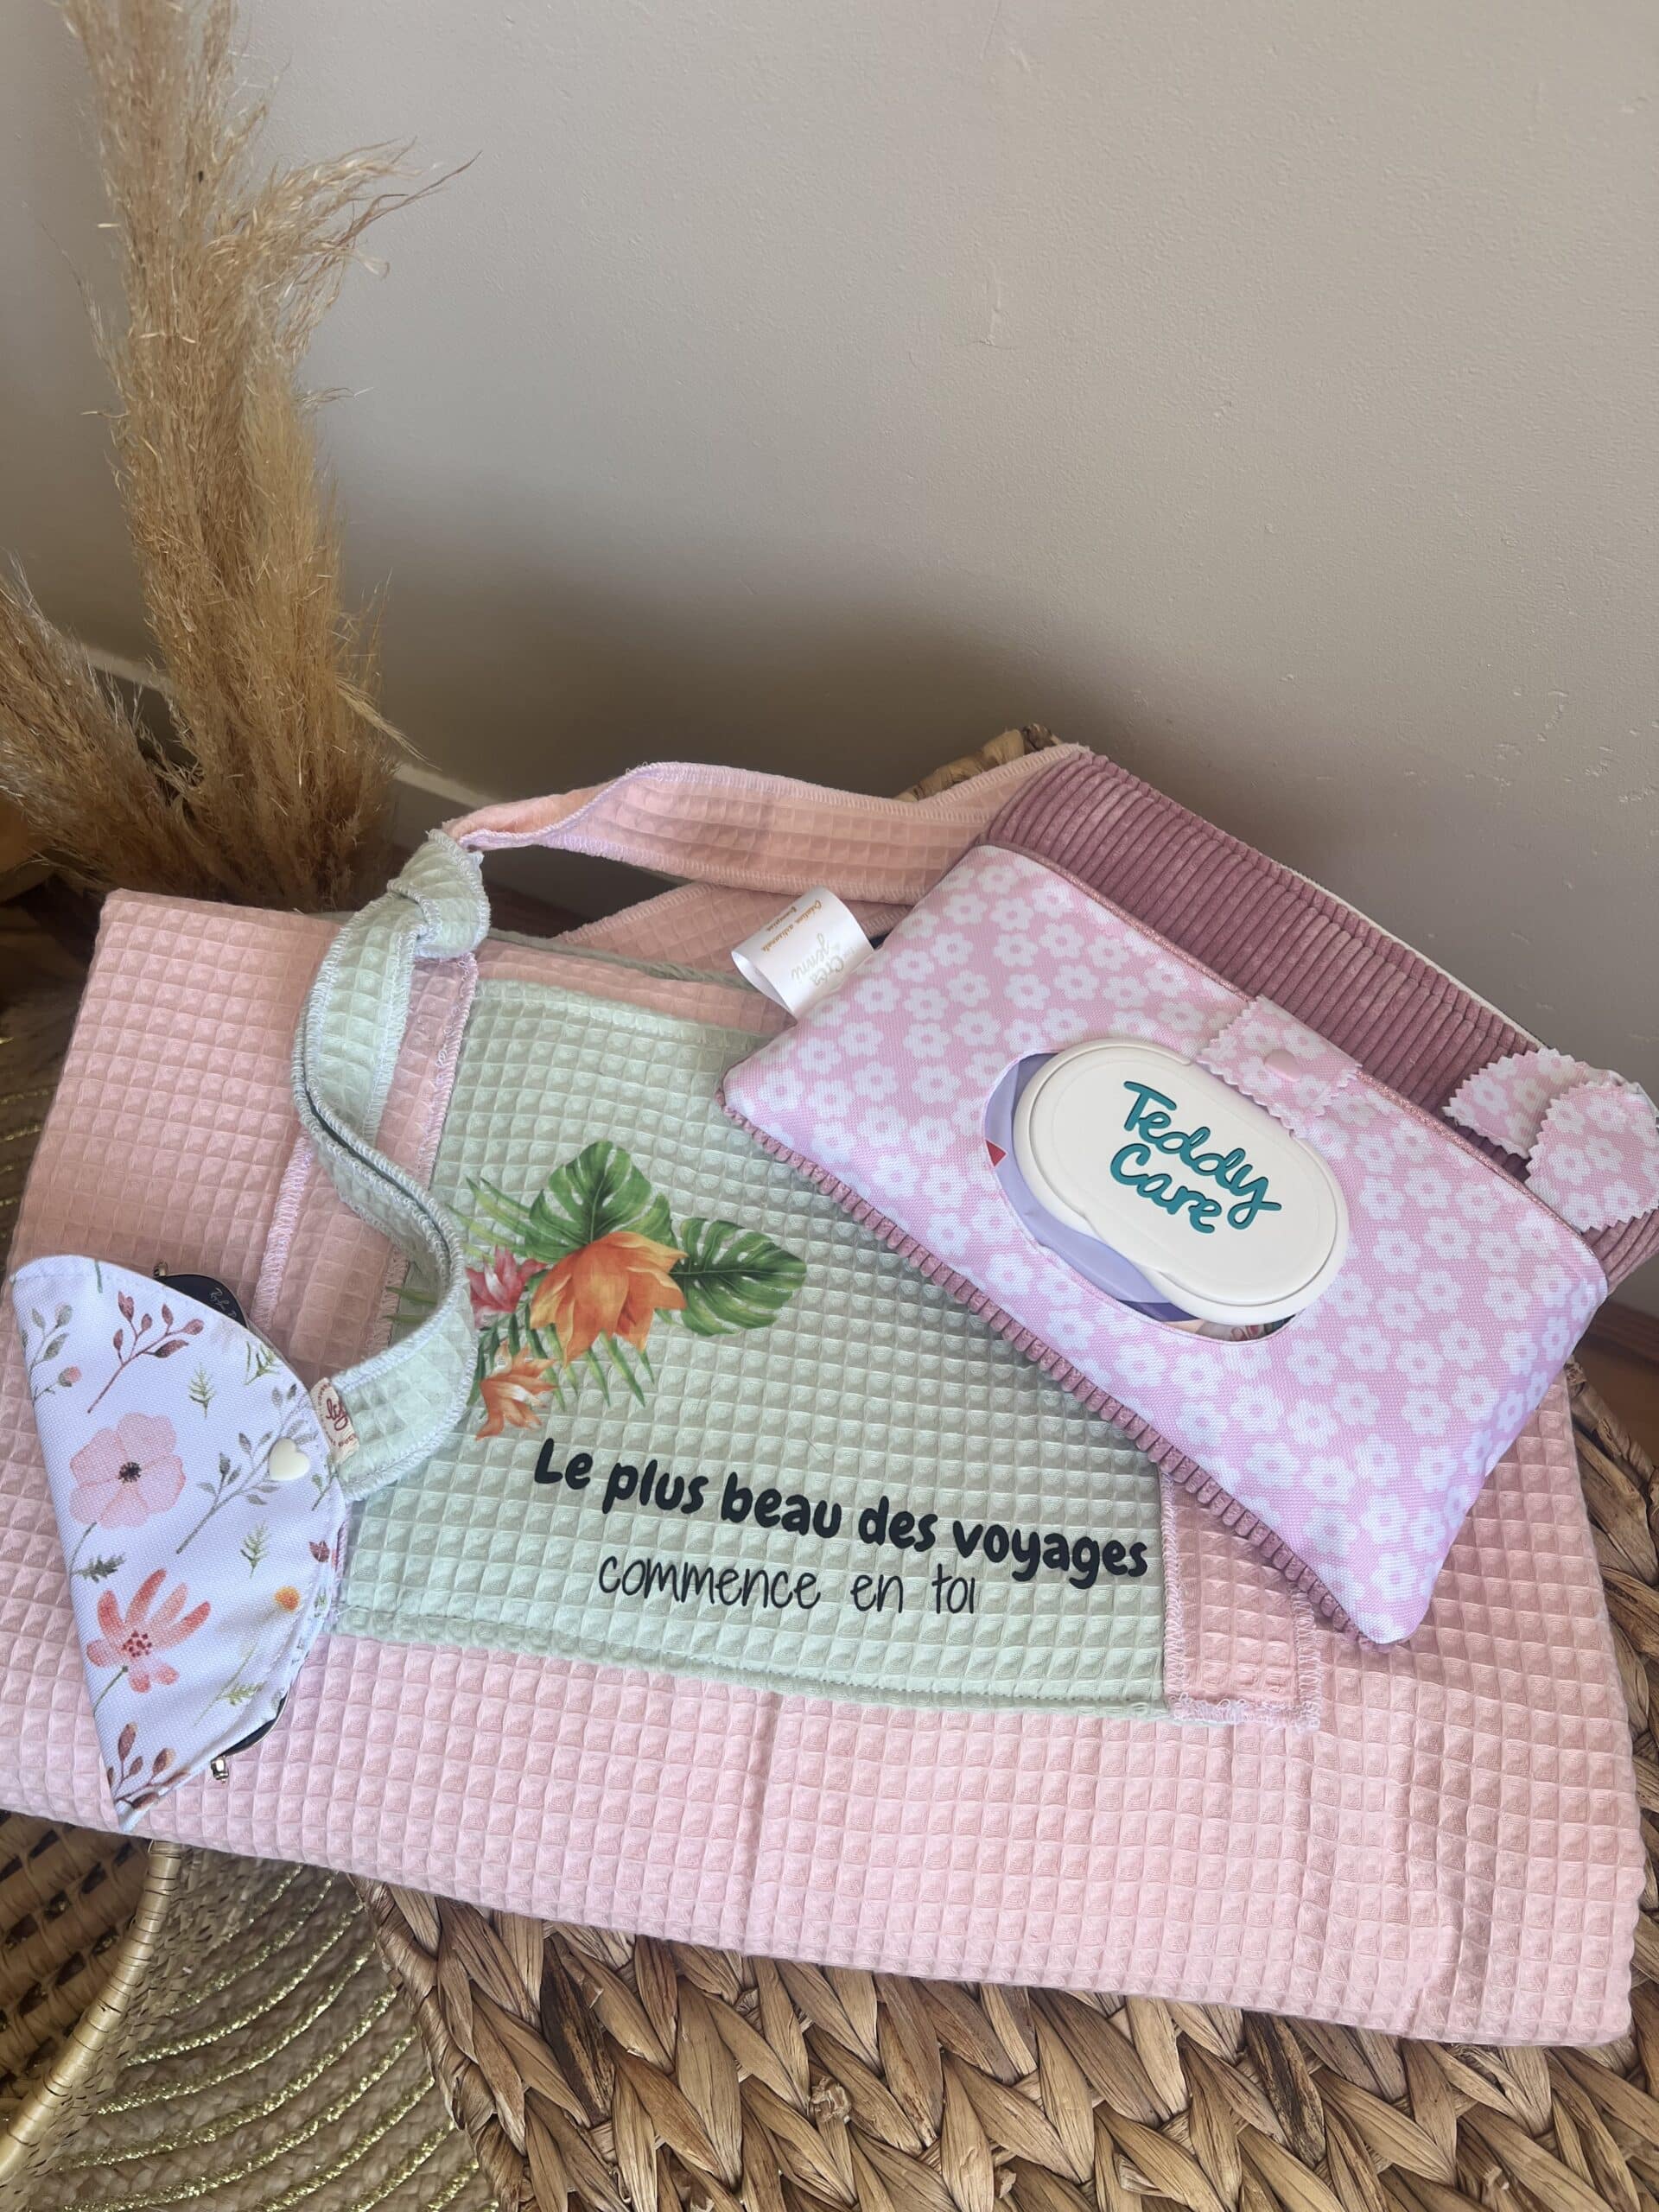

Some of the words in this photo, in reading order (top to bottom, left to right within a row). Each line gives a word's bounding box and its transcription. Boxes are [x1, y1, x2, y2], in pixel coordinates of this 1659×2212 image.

[1109, 1143, 1222, 1234] Care
[1124, 1081, 1281, 1230] Teddy
[534, 1437, 594, 1491] Le
[601, 1459, 709, 1515] plus
[721, 1471, 842, 1539] beau
[858, 1496, 938, 1553] des
[952, 1520, 1148, 1590] voyages
[599, 1555, 822, 1611] commence
[849, 1574, 904, 1614] en
